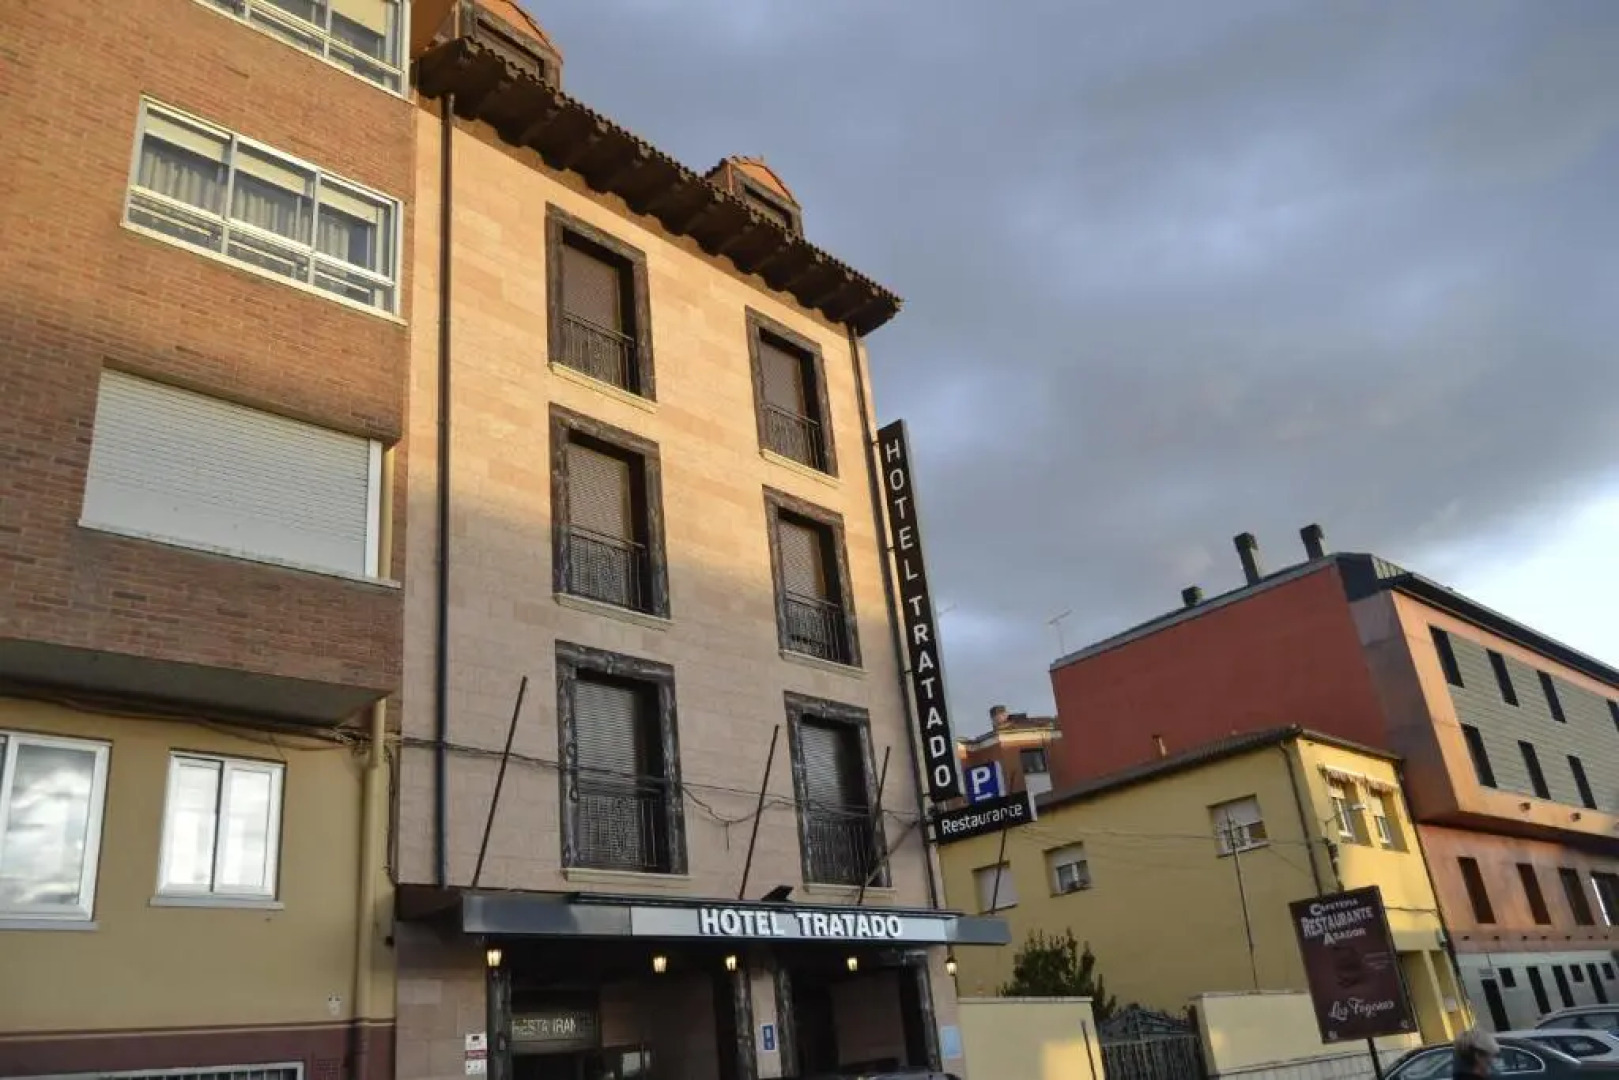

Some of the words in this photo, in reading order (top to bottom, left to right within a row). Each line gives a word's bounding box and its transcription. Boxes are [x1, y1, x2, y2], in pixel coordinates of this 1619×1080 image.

[885, 440, 917, 580] HOTEL
[908, 595, 951, 787] TRATADO
[971, 767, 991, 795] P
[942, 804, 1022, 834] Restaurante
[700, 908, 785, 936] HOTEL
[795, 911, 903, 937] TRATADO
[1301, 907, 1374, 937] RESTAURANTE
